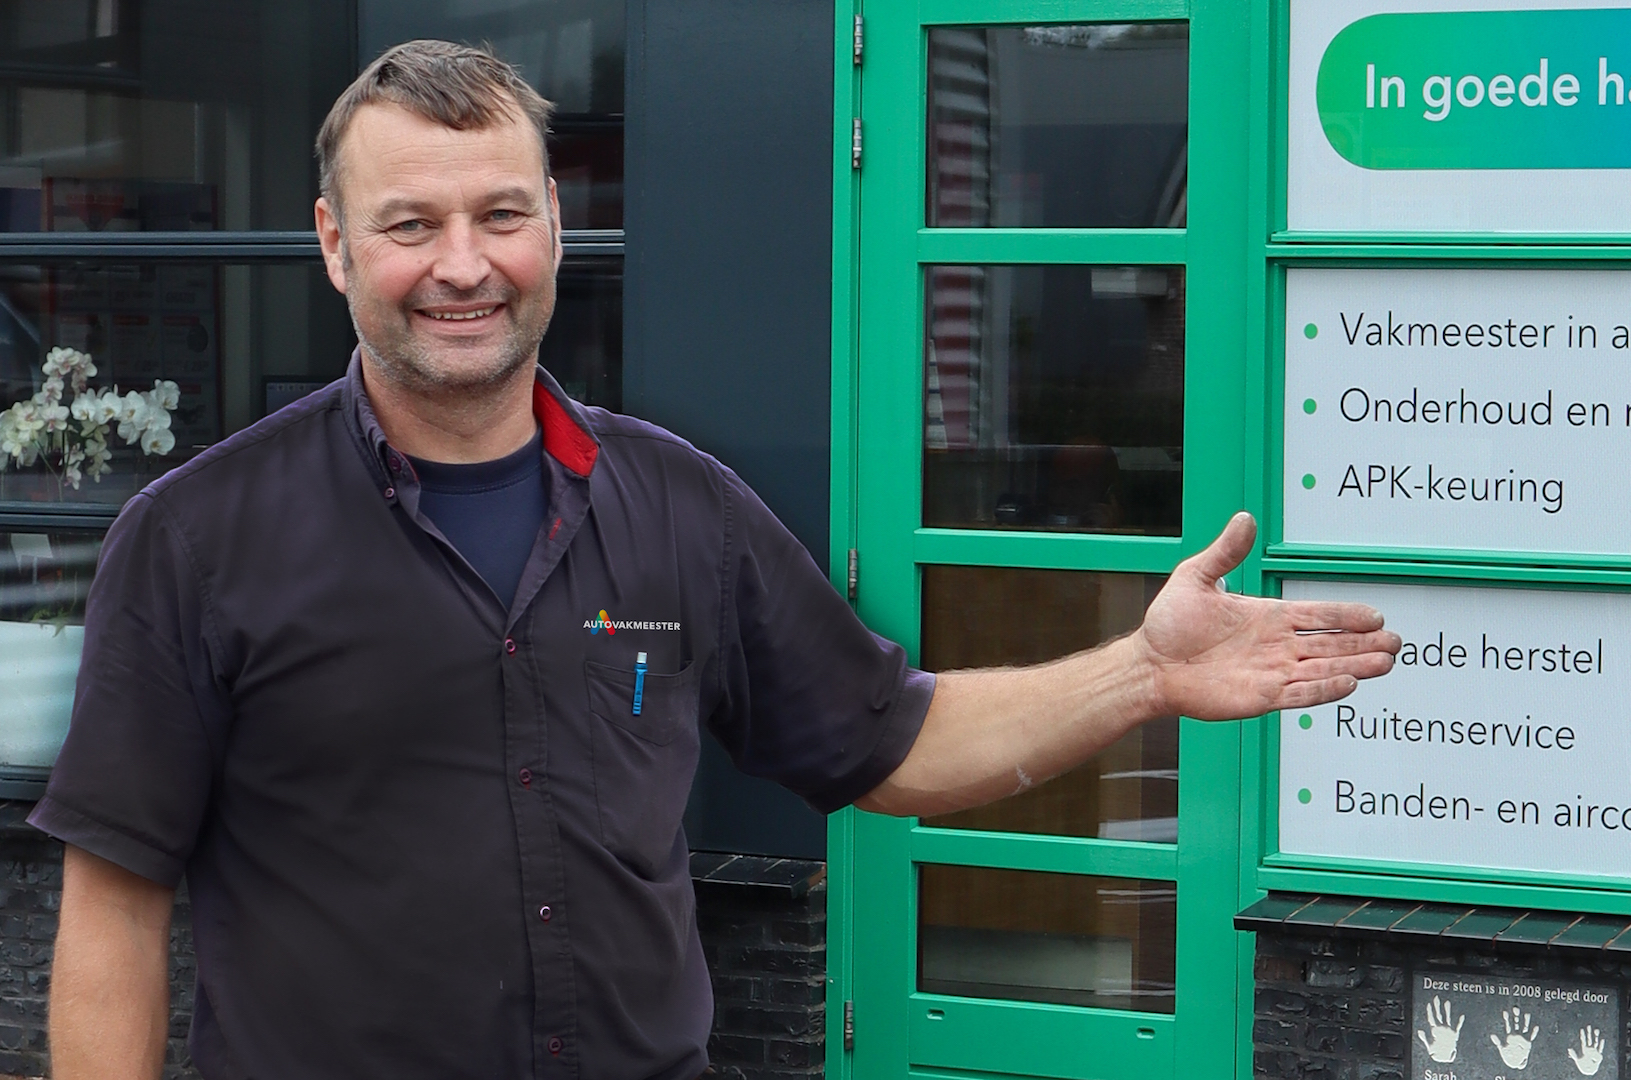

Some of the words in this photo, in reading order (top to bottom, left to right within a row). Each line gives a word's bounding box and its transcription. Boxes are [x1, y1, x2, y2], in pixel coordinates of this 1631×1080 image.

[1366, 64, 1405, 108] In
[1422, 58, 1580, 122] goede
[1598, 57, 1631, 105] h
[1339, 310, 1555, 348] Vakmeester
[1568, 315, 1597, 349] in
[1340, 387, 1552, 426] Onderhoud
[1566, 402, 1610, 427] en
[1337, 464, 1563, 514] APK-keuring
[583, 620, 681, 631] AUTOVAKMEESTER
[1393, 631, 1467, 668] ade
[1482, 633, 1602, 674] herstel
[1336, 704, 1575, 750] Ruitenservice
[1335, 779, 1484, 821] Banden-
[1497, 800, 1539, 825] en
[1423, 977, 1450, 991] Deze
[1453, 981, 1482, 994] steen
[1485, 983, 1496, 995] is
[1498, 984, 1510, 996] in
[1512, 984, 1542, 998] 2008
[1544, 987, 1580, 1004] gelegd
[1583, 990, 1609, 1004] door
